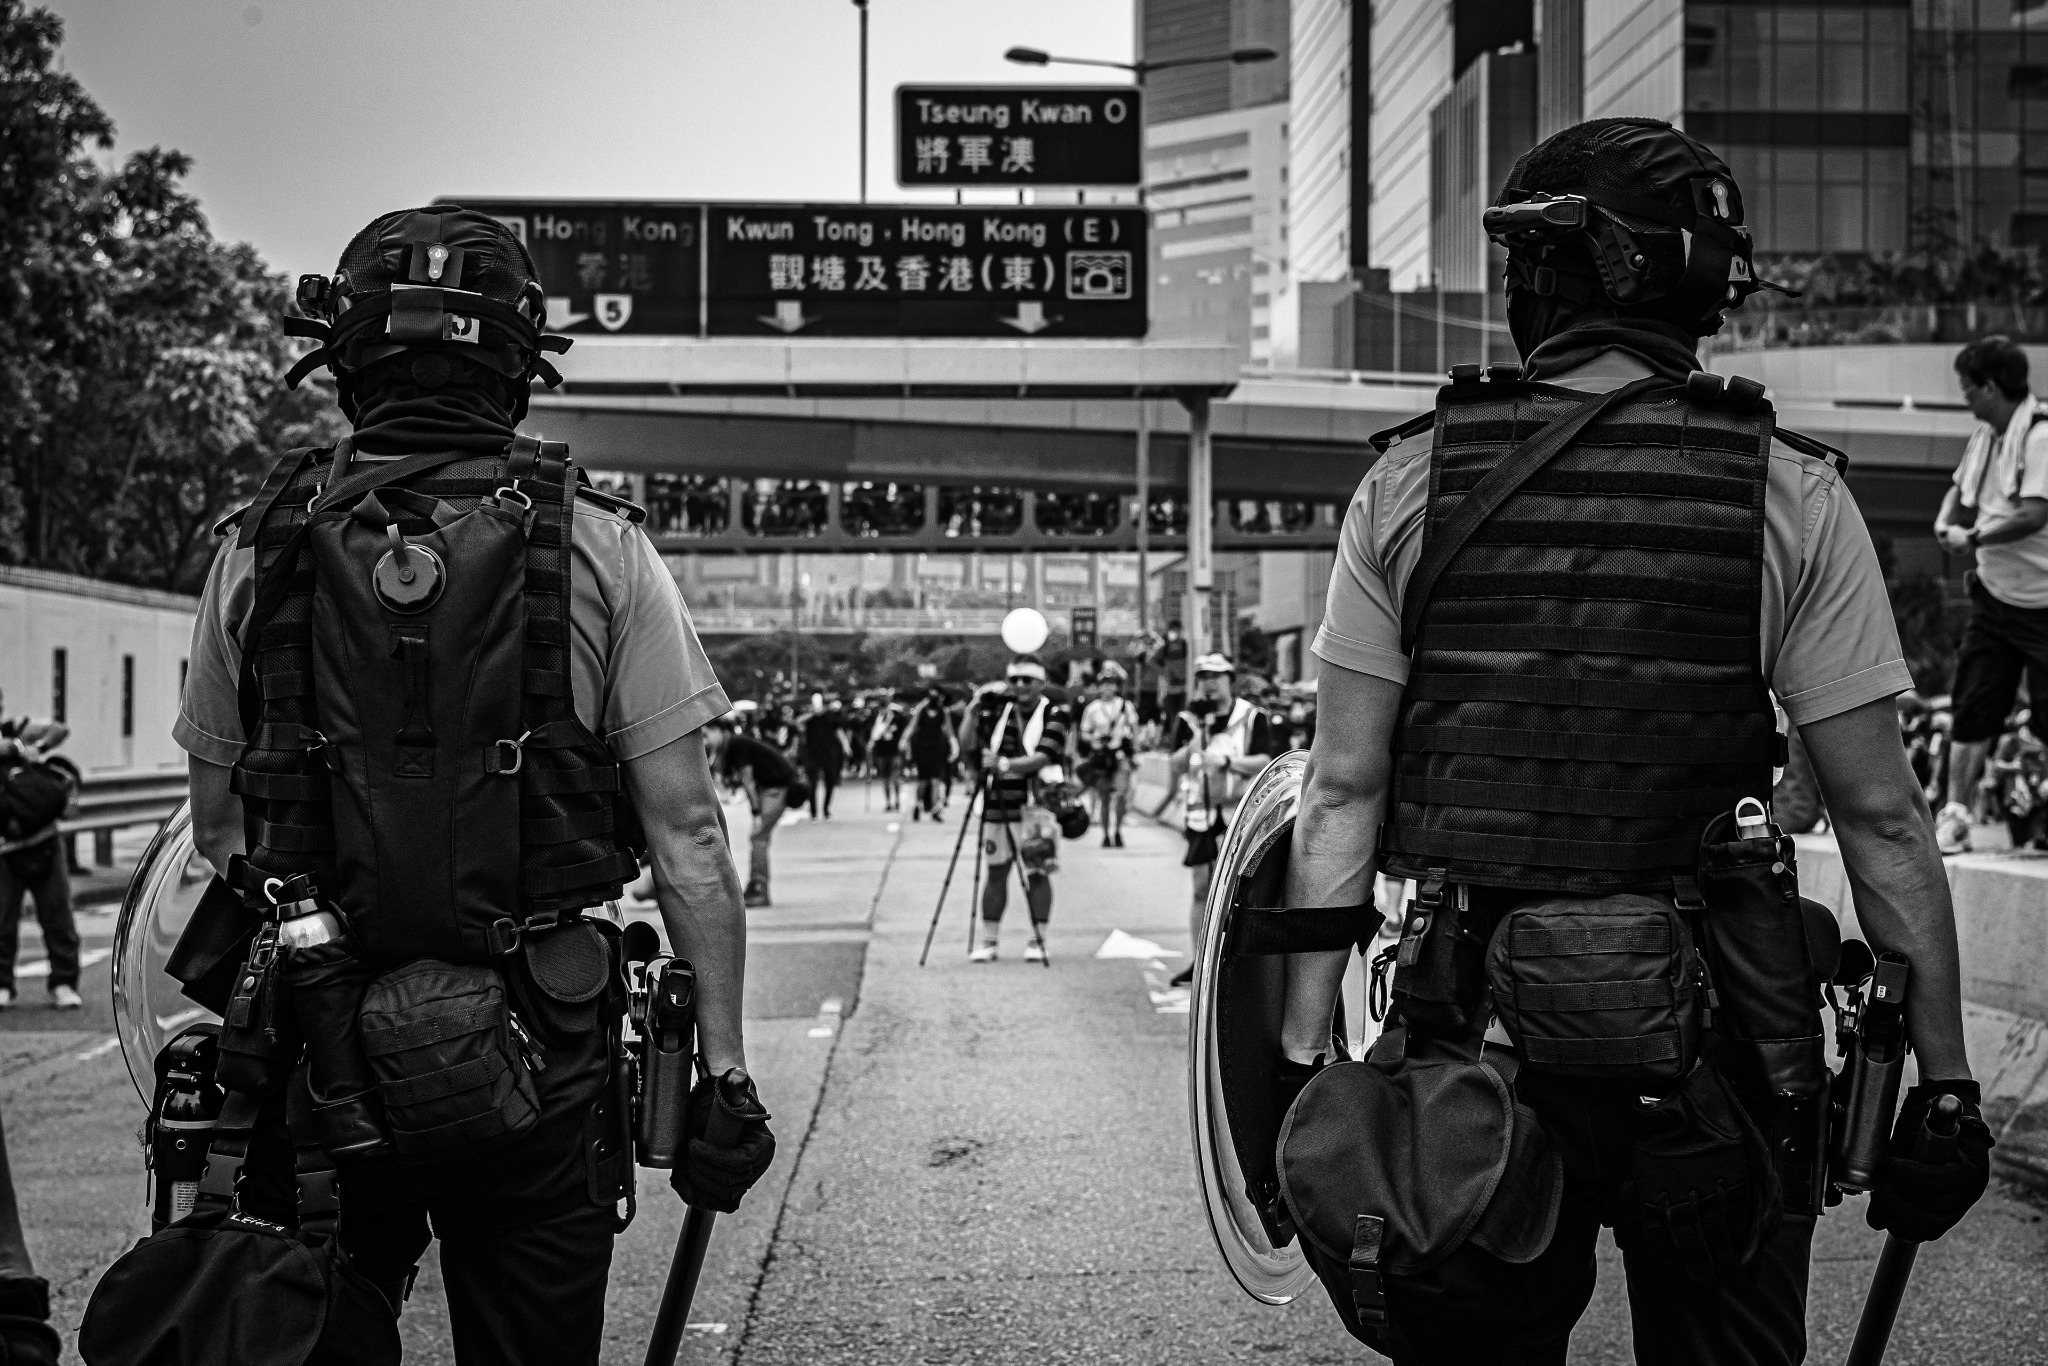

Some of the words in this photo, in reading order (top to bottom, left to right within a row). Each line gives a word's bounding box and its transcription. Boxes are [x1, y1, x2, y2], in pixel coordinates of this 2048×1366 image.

[916, 99, 1010, 129] Tseung
[1021, 99, 1092, 124] Kwan
[1104, 98, 1127, 124] O
[915, 135, 1035, 174] 將軍澳
[532, 213, 607, 246] Hong
[622, 215, 695, 247] Kong
[727, 215, 794, 241] Kwun
[812, 215, 874, 247] Tong
[901, 217, 966, 248] Hong
[983, 217, 1047, 248] Kong
[605, 301, 622, 323] 5
